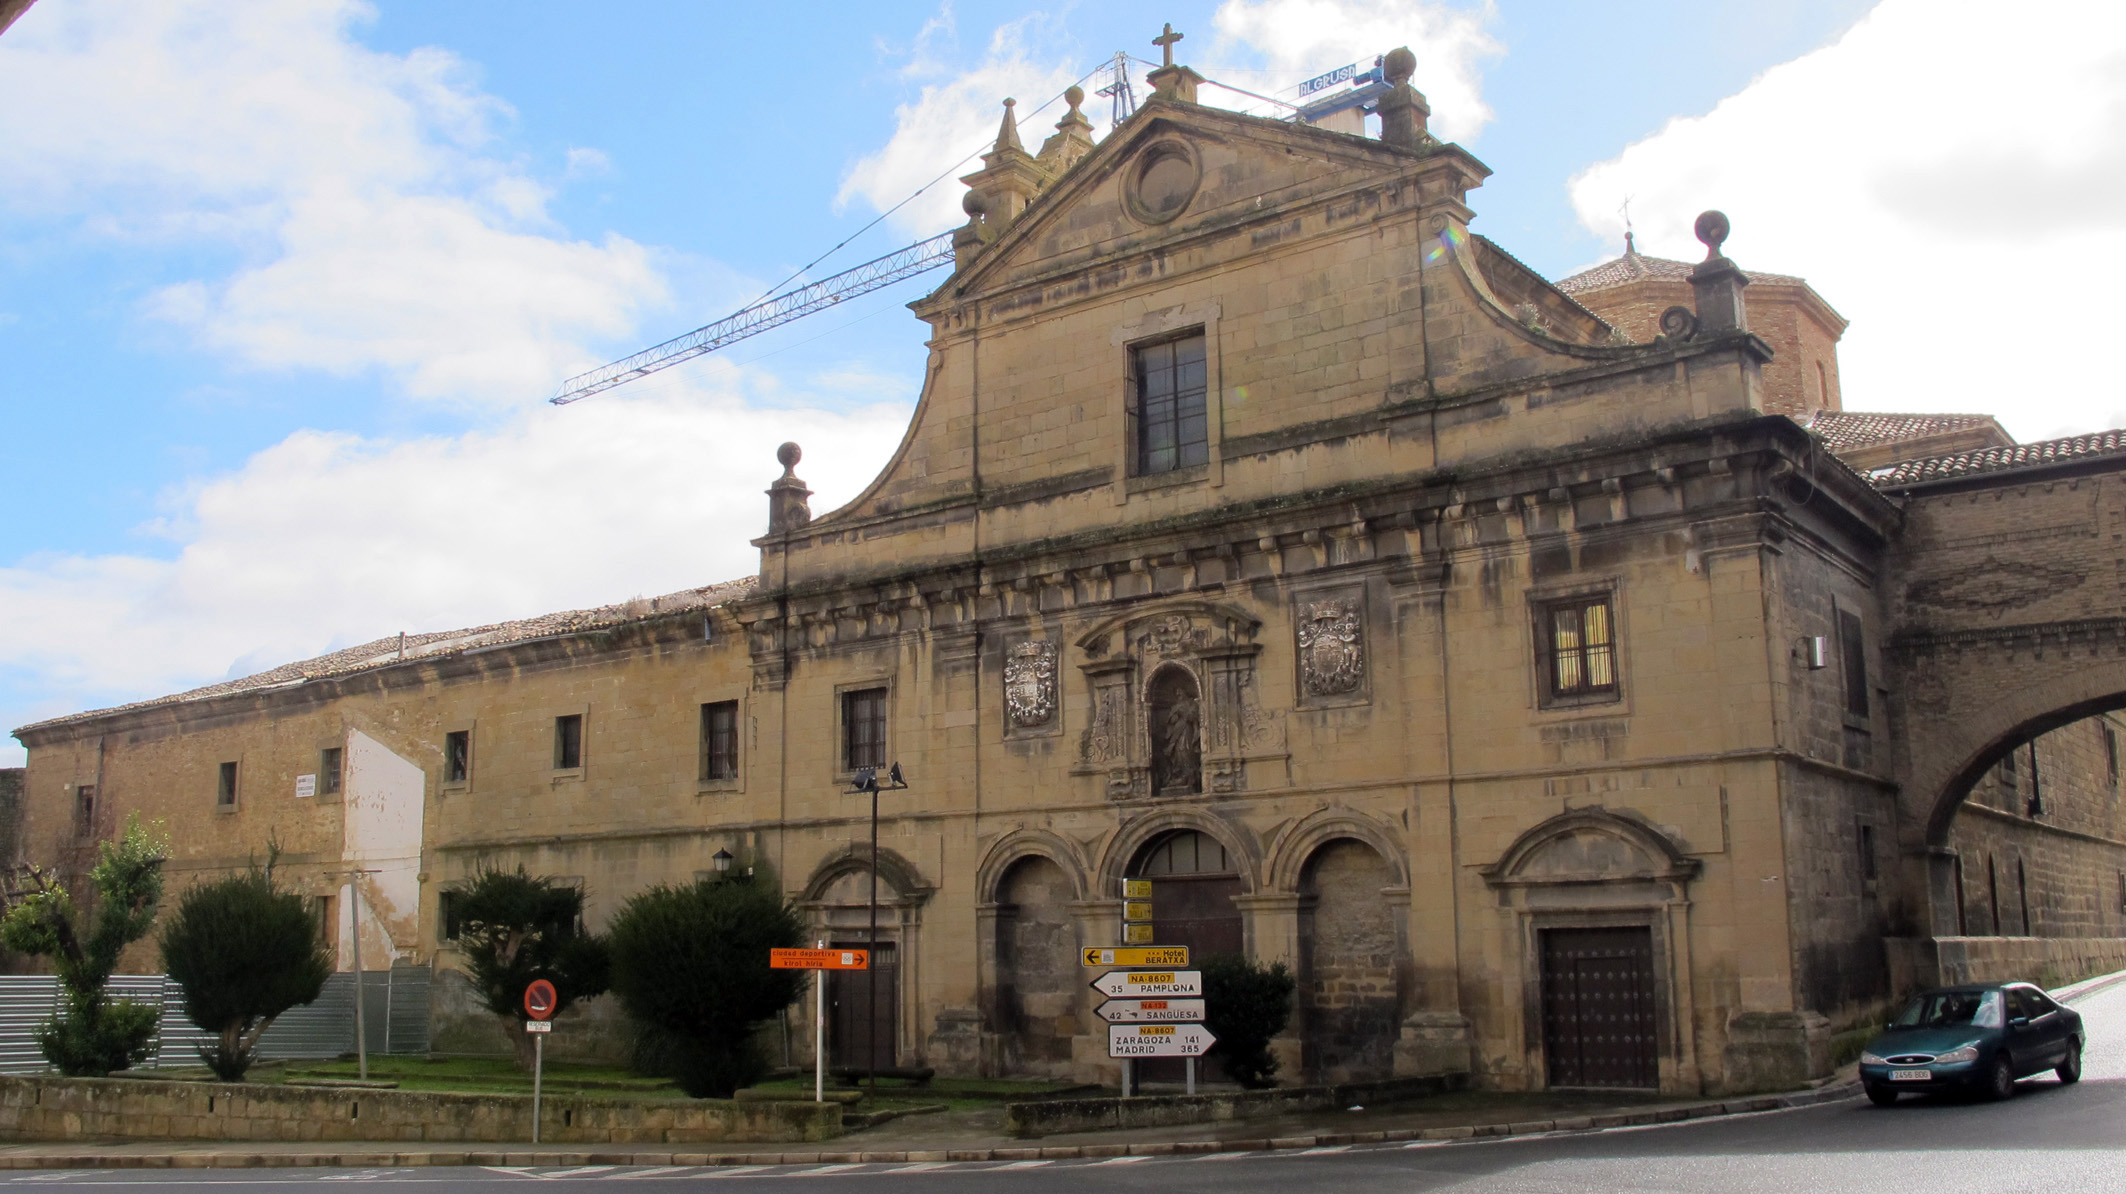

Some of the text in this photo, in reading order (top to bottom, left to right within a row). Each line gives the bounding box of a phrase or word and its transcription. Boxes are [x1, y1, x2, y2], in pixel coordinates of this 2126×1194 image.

[1300, 65, 1356, 97] ALGRUSA
[1163, 949, 1185, 957] Hotel
[1145, 956, 1185, 964] BERATXA
[1110, 984, 1195, 993] 35 PAMPLONA
[1109, 1010, 1199, 1020] 42 SANGÜESA
[1116, 1035, 1200, 1045] ZARAGOZA 141
[1116, 1044, 1200, 1054] MADRID 365
